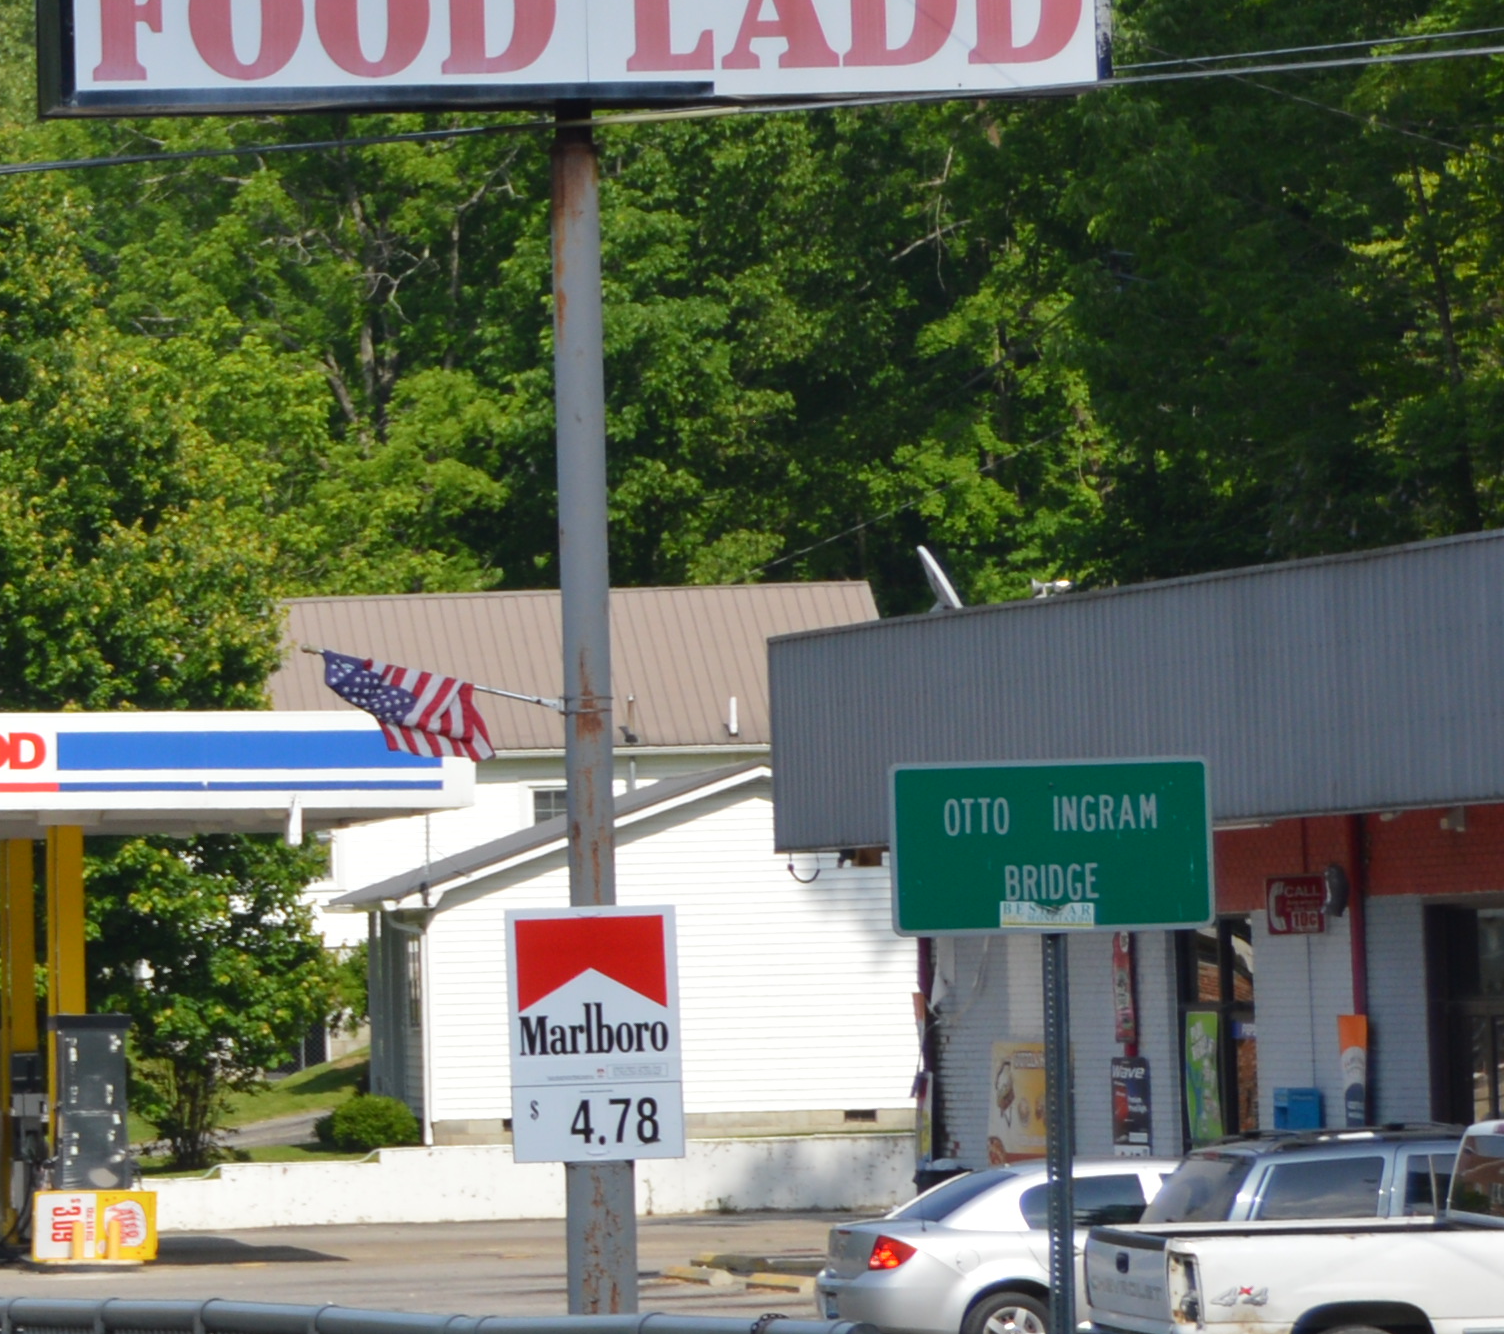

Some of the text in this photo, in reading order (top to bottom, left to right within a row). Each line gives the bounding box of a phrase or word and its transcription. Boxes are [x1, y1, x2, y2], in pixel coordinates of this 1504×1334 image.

[944, 793, 1158, 836] OTTO INGRAM
[1004, 863, 1100, 901] BRIDGE
[1284, 883, 1321, 897] CALL
[519, 1003, 669, 1056] Marlboro
[1112, 1065, 1145, 1079] Wave
[571, 1097, 659, 1145] 4.78
